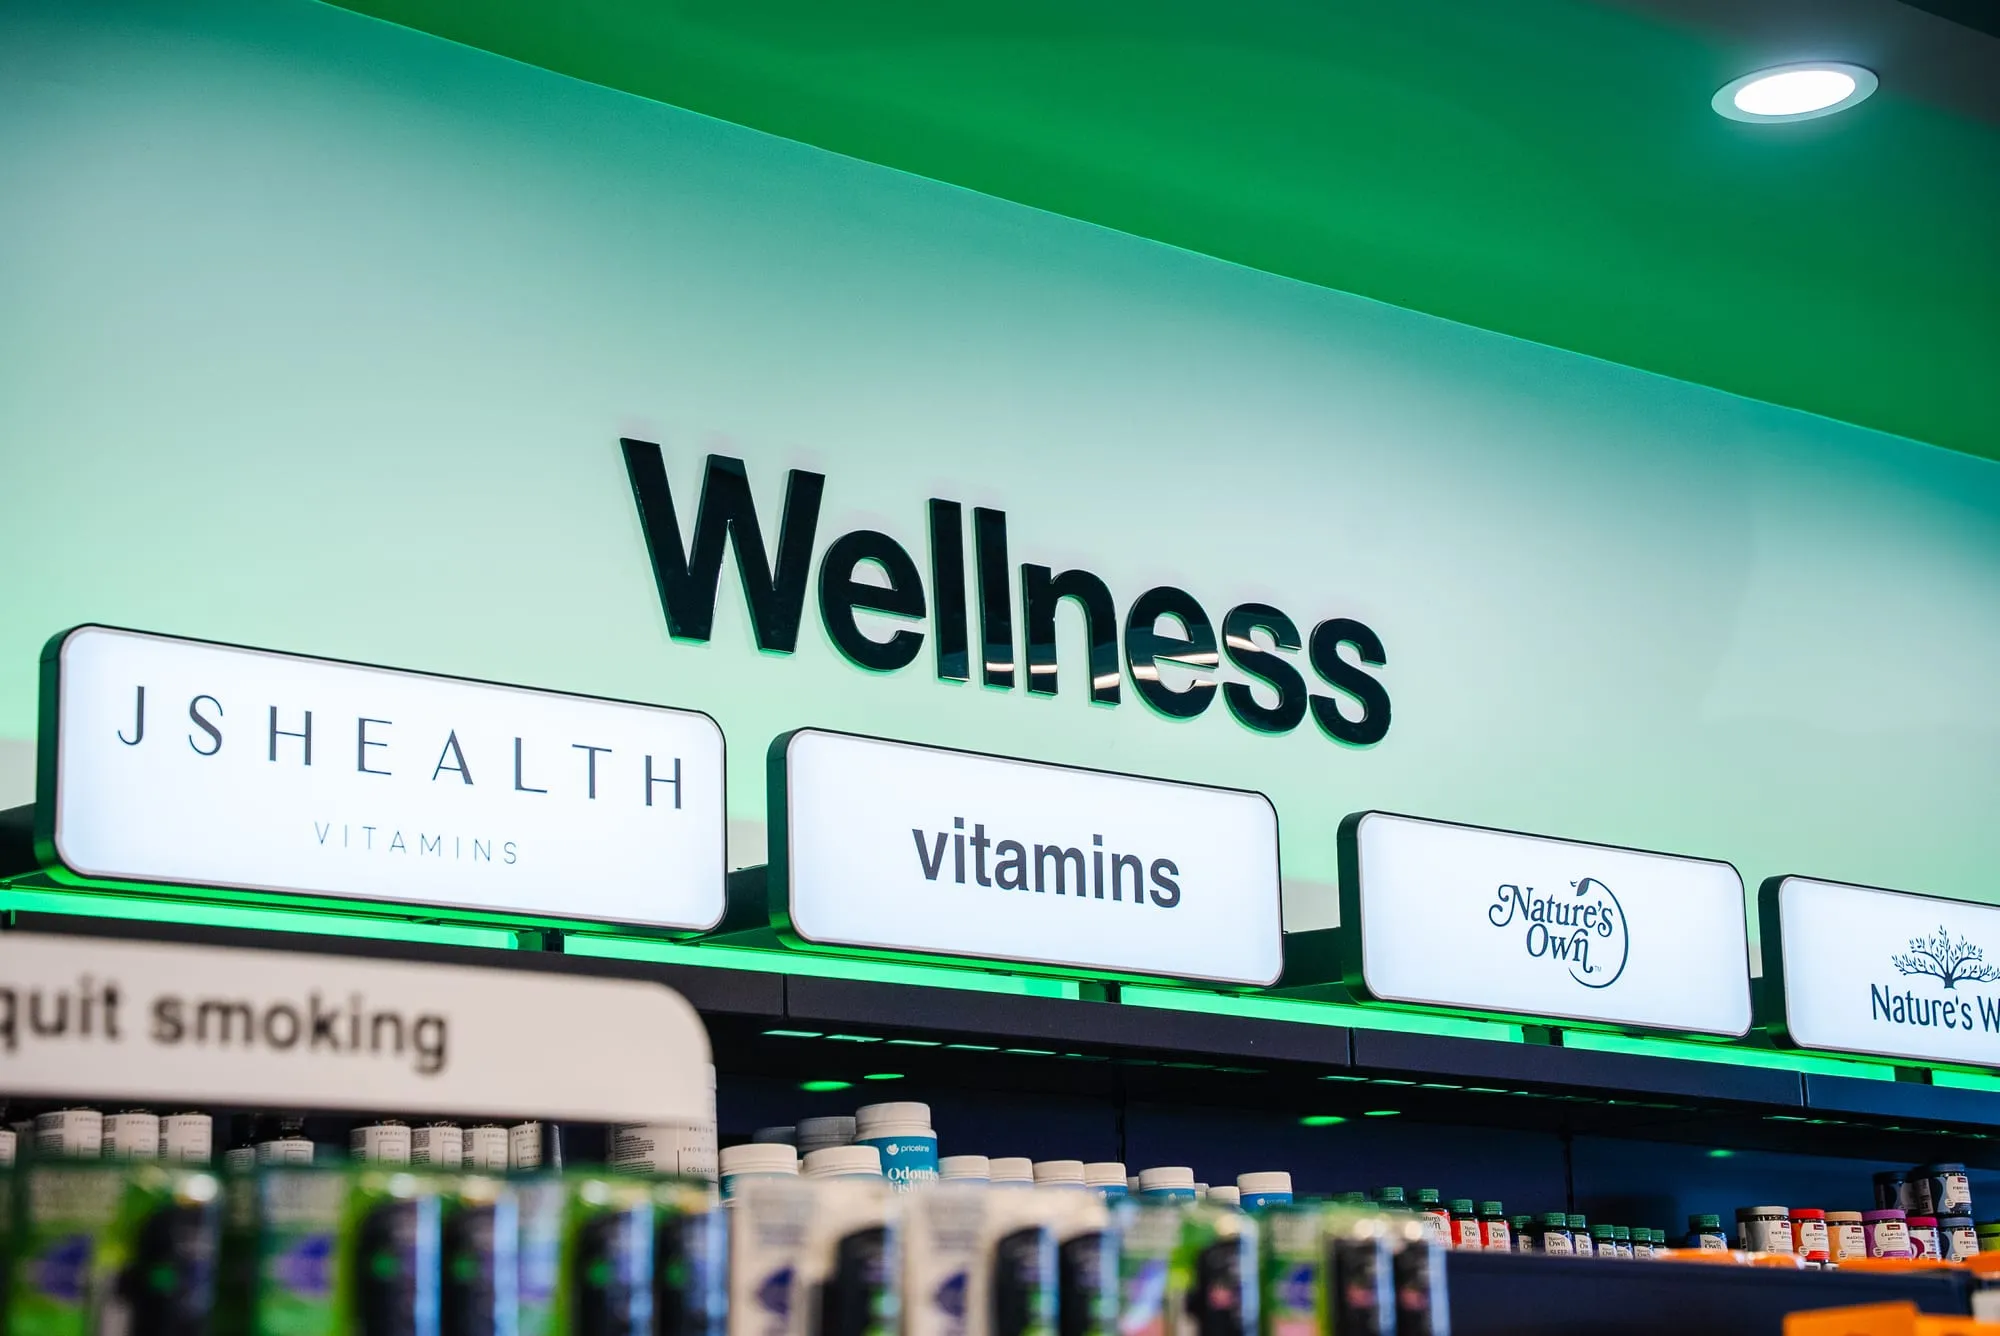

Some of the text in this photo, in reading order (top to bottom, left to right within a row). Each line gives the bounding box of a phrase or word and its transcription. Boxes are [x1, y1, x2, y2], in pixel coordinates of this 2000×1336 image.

[620, 437, 1392, 744] Wellness
[117, 685, 685, 810] JSHEALTH
[314, 822, 519, 865] VITAMINS
[912, 816, 1182, 909] vitamins
[1488, 884, 1613, 938] Nature's
[1526, 923, 1594, 974] Own
[0, 972, 449, 1076] quit smoking
[1871, 983, 1973, 1031] Nature's
